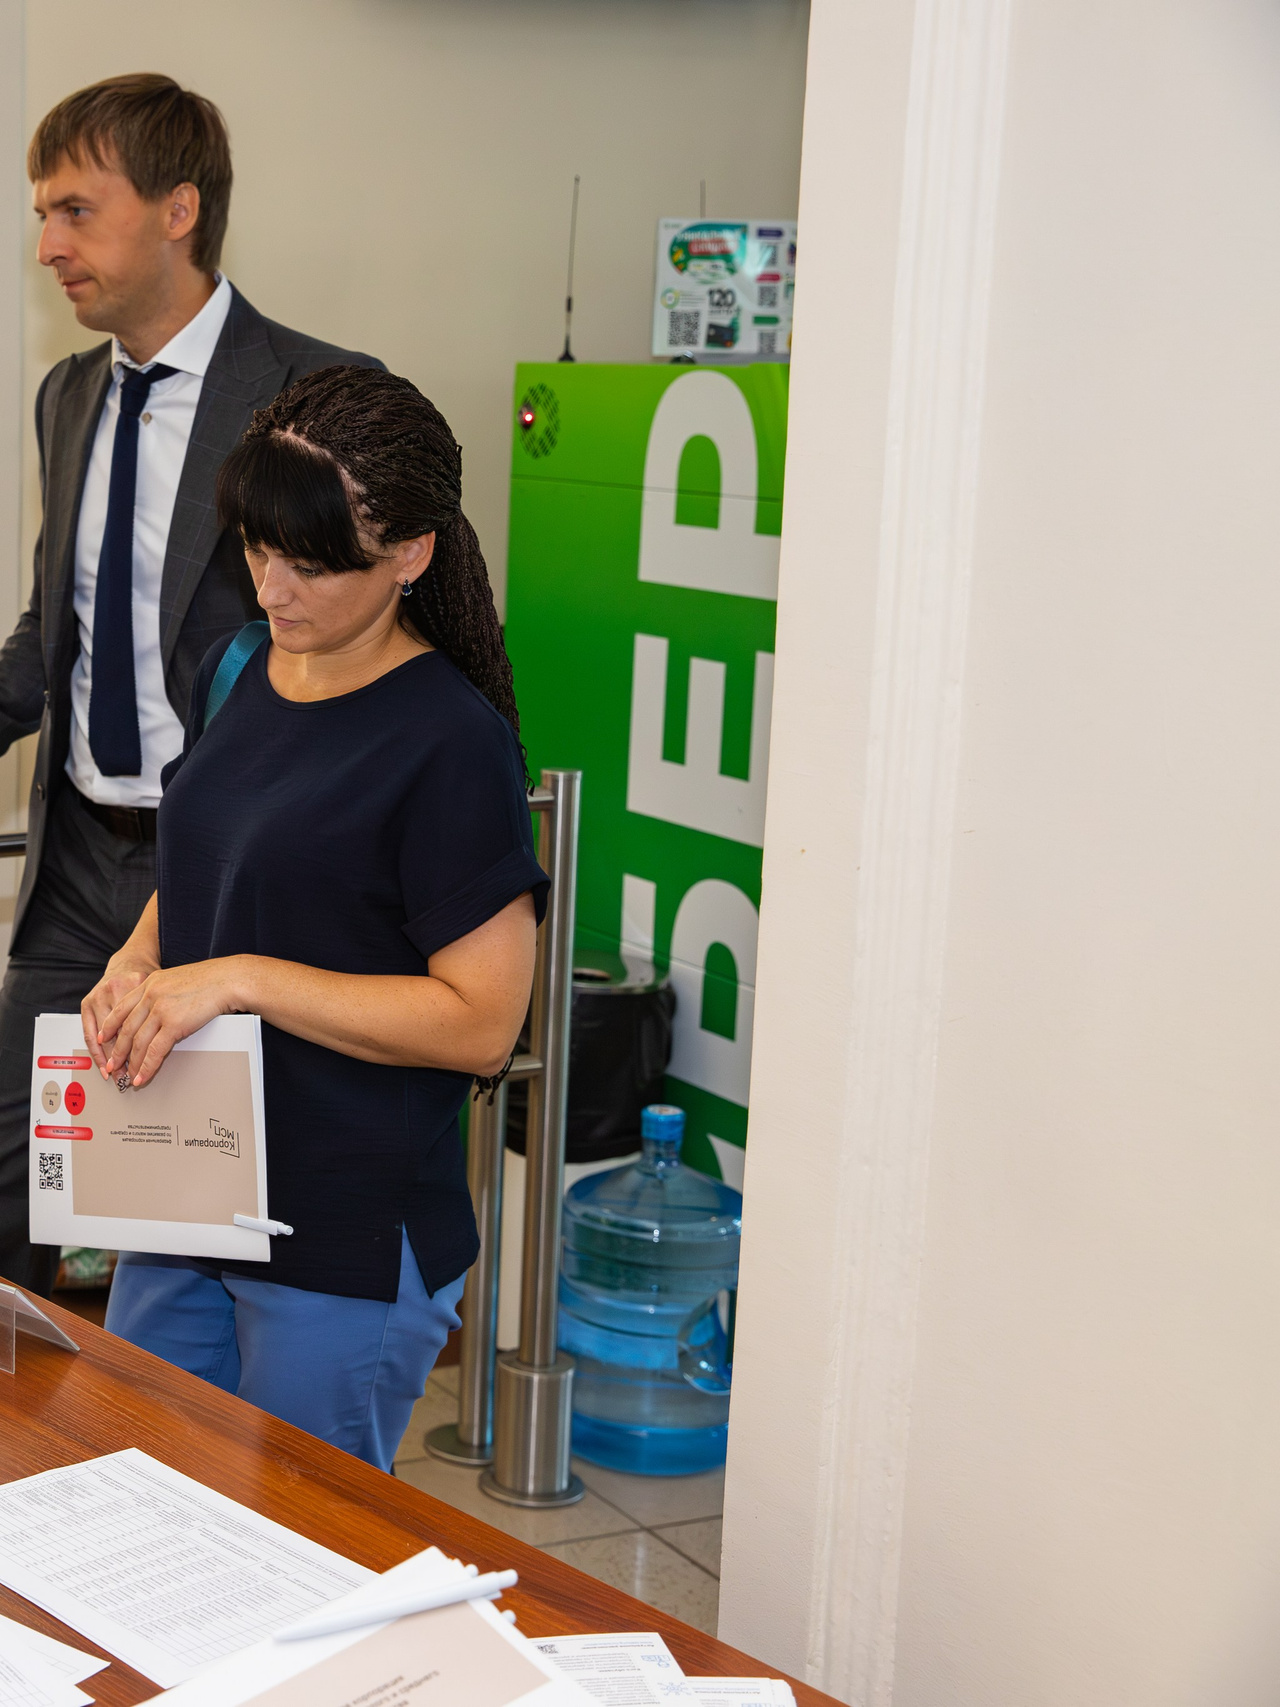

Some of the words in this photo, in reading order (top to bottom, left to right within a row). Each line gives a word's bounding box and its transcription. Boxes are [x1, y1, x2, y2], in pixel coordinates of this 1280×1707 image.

[708, 287, 736, 308] 120
[618, 369, 780, 1192] БЕР
[214, 1125, 235, 1140] МСП
[184, 1138, 235, 1151] Корпорация
